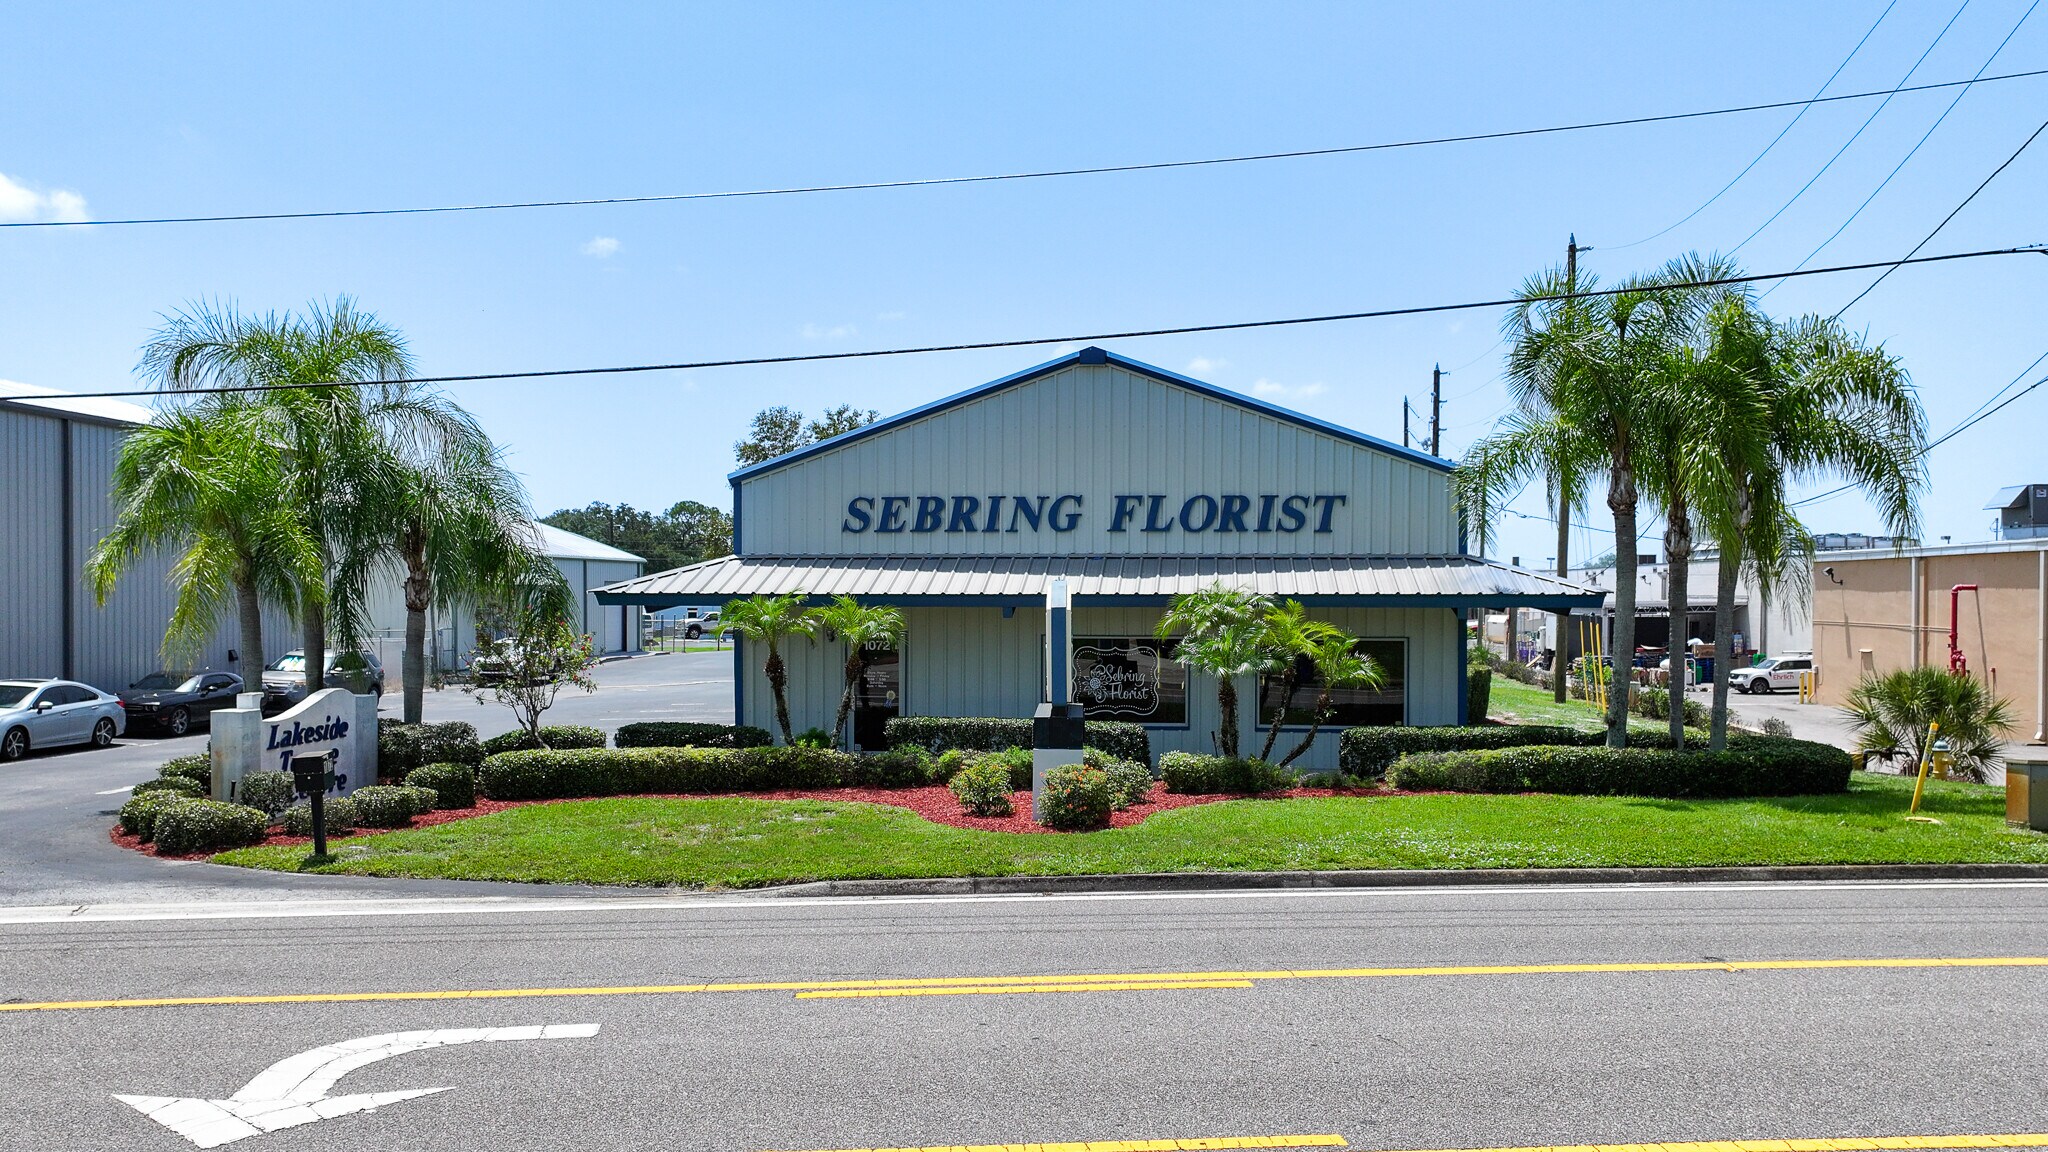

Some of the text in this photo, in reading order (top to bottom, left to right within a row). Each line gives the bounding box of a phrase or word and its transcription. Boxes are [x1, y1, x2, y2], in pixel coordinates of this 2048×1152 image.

[842, 495, 1347, 534] SEBRING FLORIST
[863, 640, 891, 651] 1072
[1105, 664, 1146, 687] Sebring
[1108, 682, 1149, 700] Florist
[266, 715, 349, 751] Lakeside
